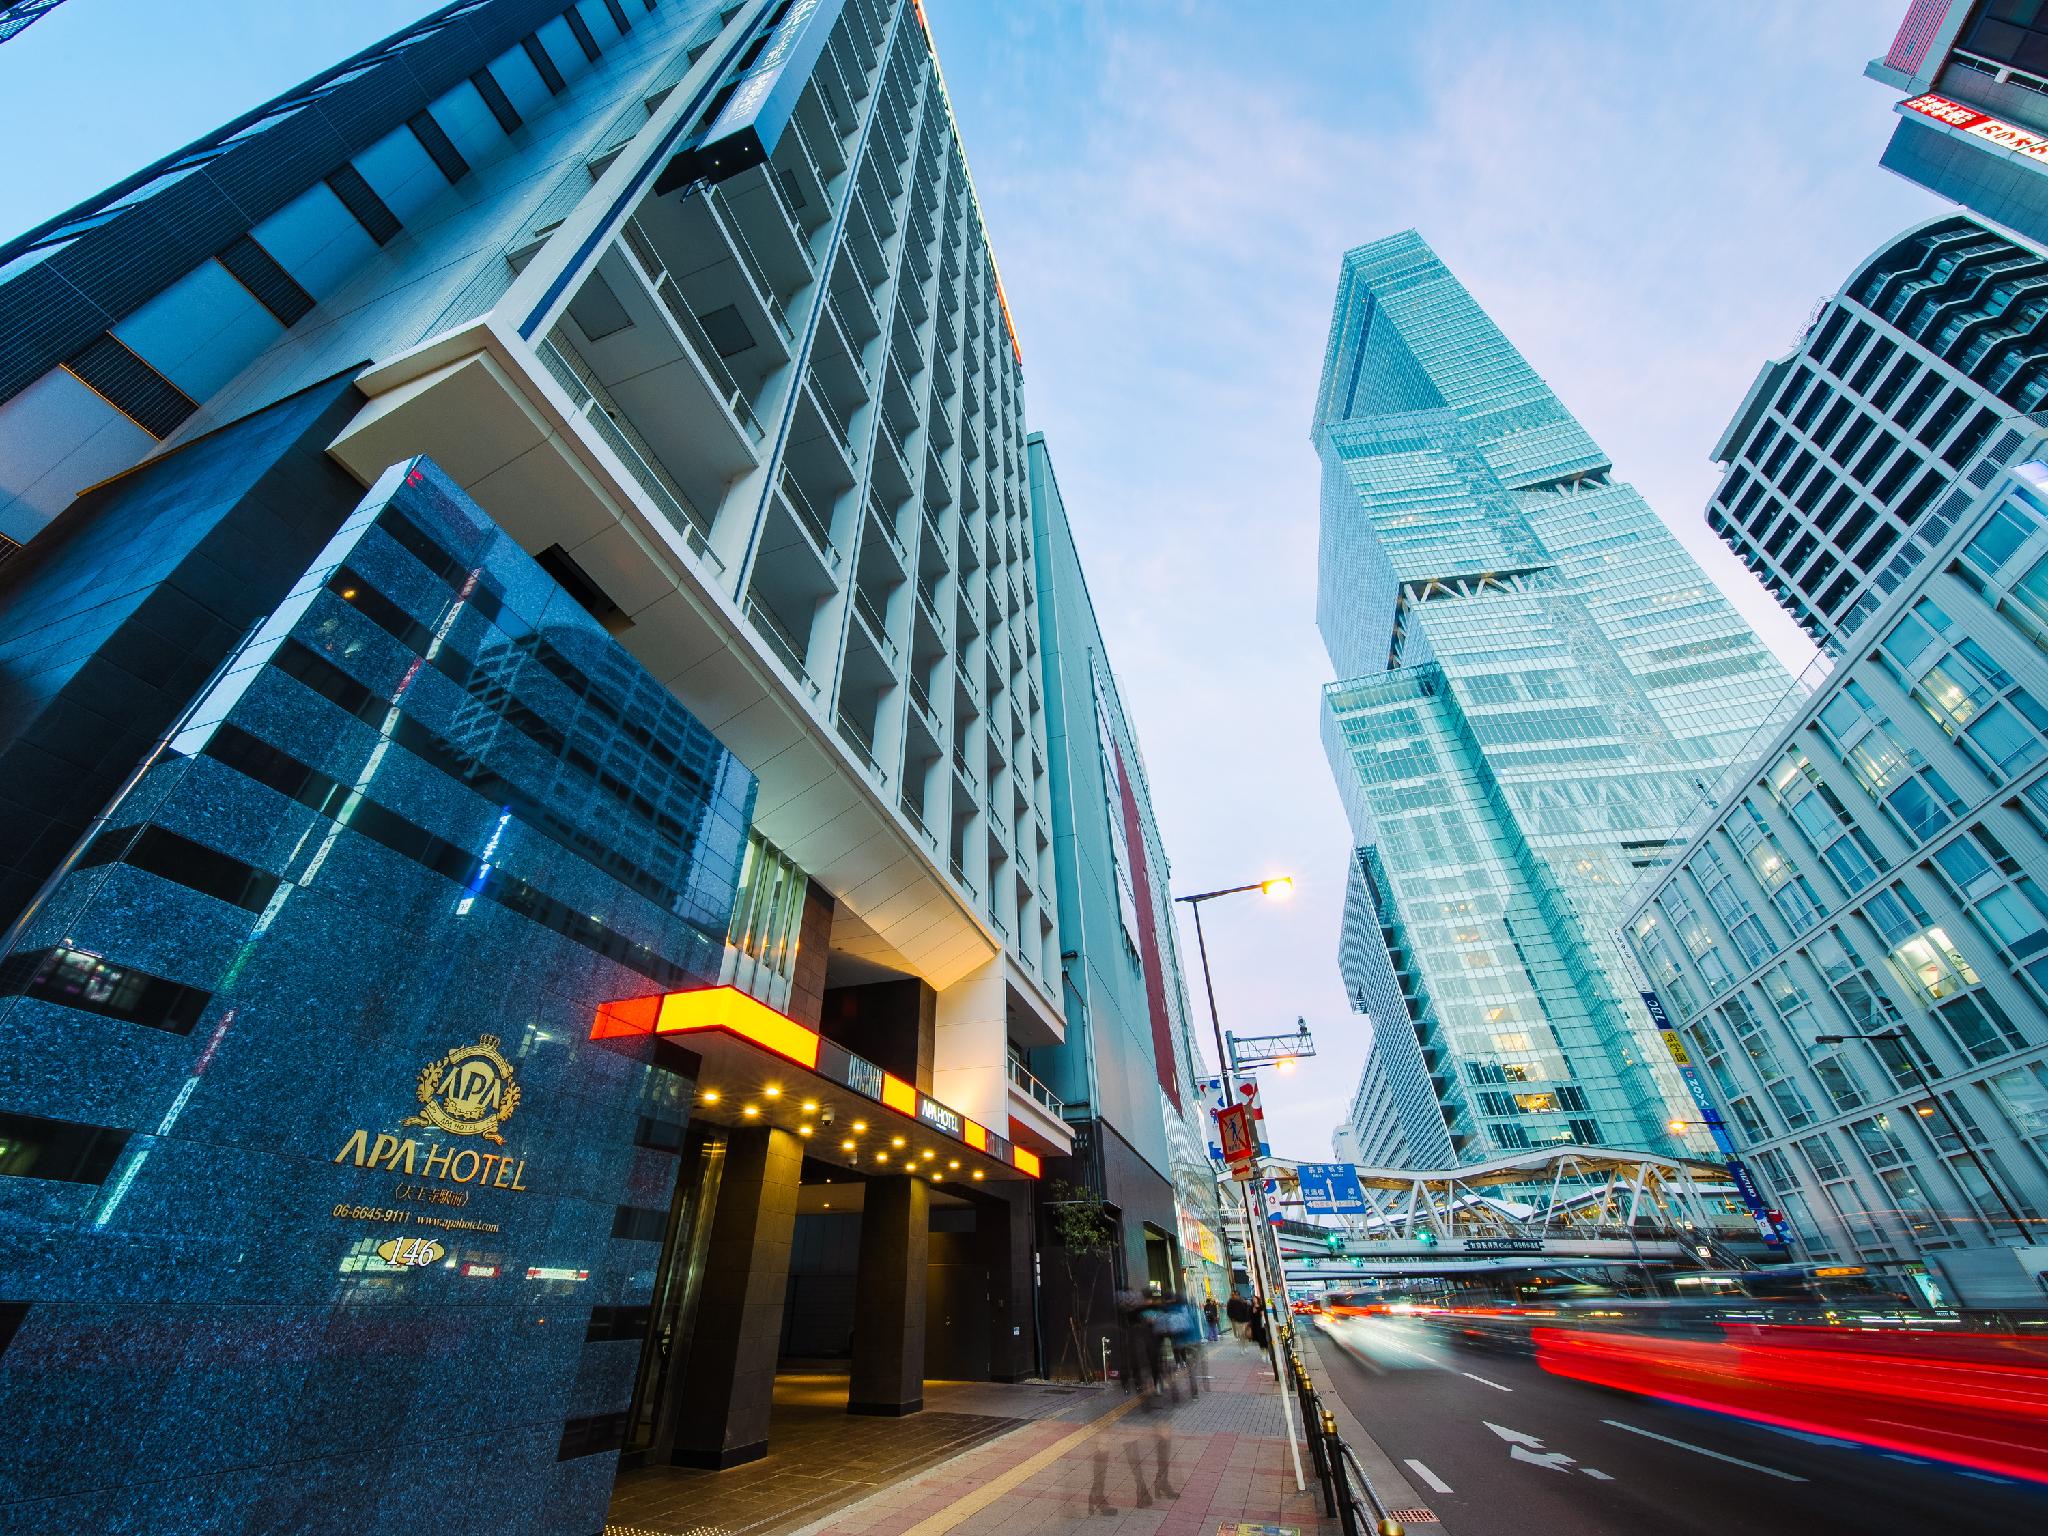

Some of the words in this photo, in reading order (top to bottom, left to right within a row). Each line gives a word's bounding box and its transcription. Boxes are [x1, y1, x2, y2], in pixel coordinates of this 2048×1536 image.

[437, 1066, 501, 1110] APA
[1689, 1079, 1710, 1107] NOVA
[922, 1099, 937, 1121] APA
[937, 1107, 959, 1133] HOTEL
[333, 1129, 417, 1175] APA
[422, 1143, 528, 1191] HOTEL
[332, 1204, 411, 1223] 06-6645-9111
[416, 1214, 499, 1233] www.apahotel.com
[387, 1236, 439, 1267] 146
